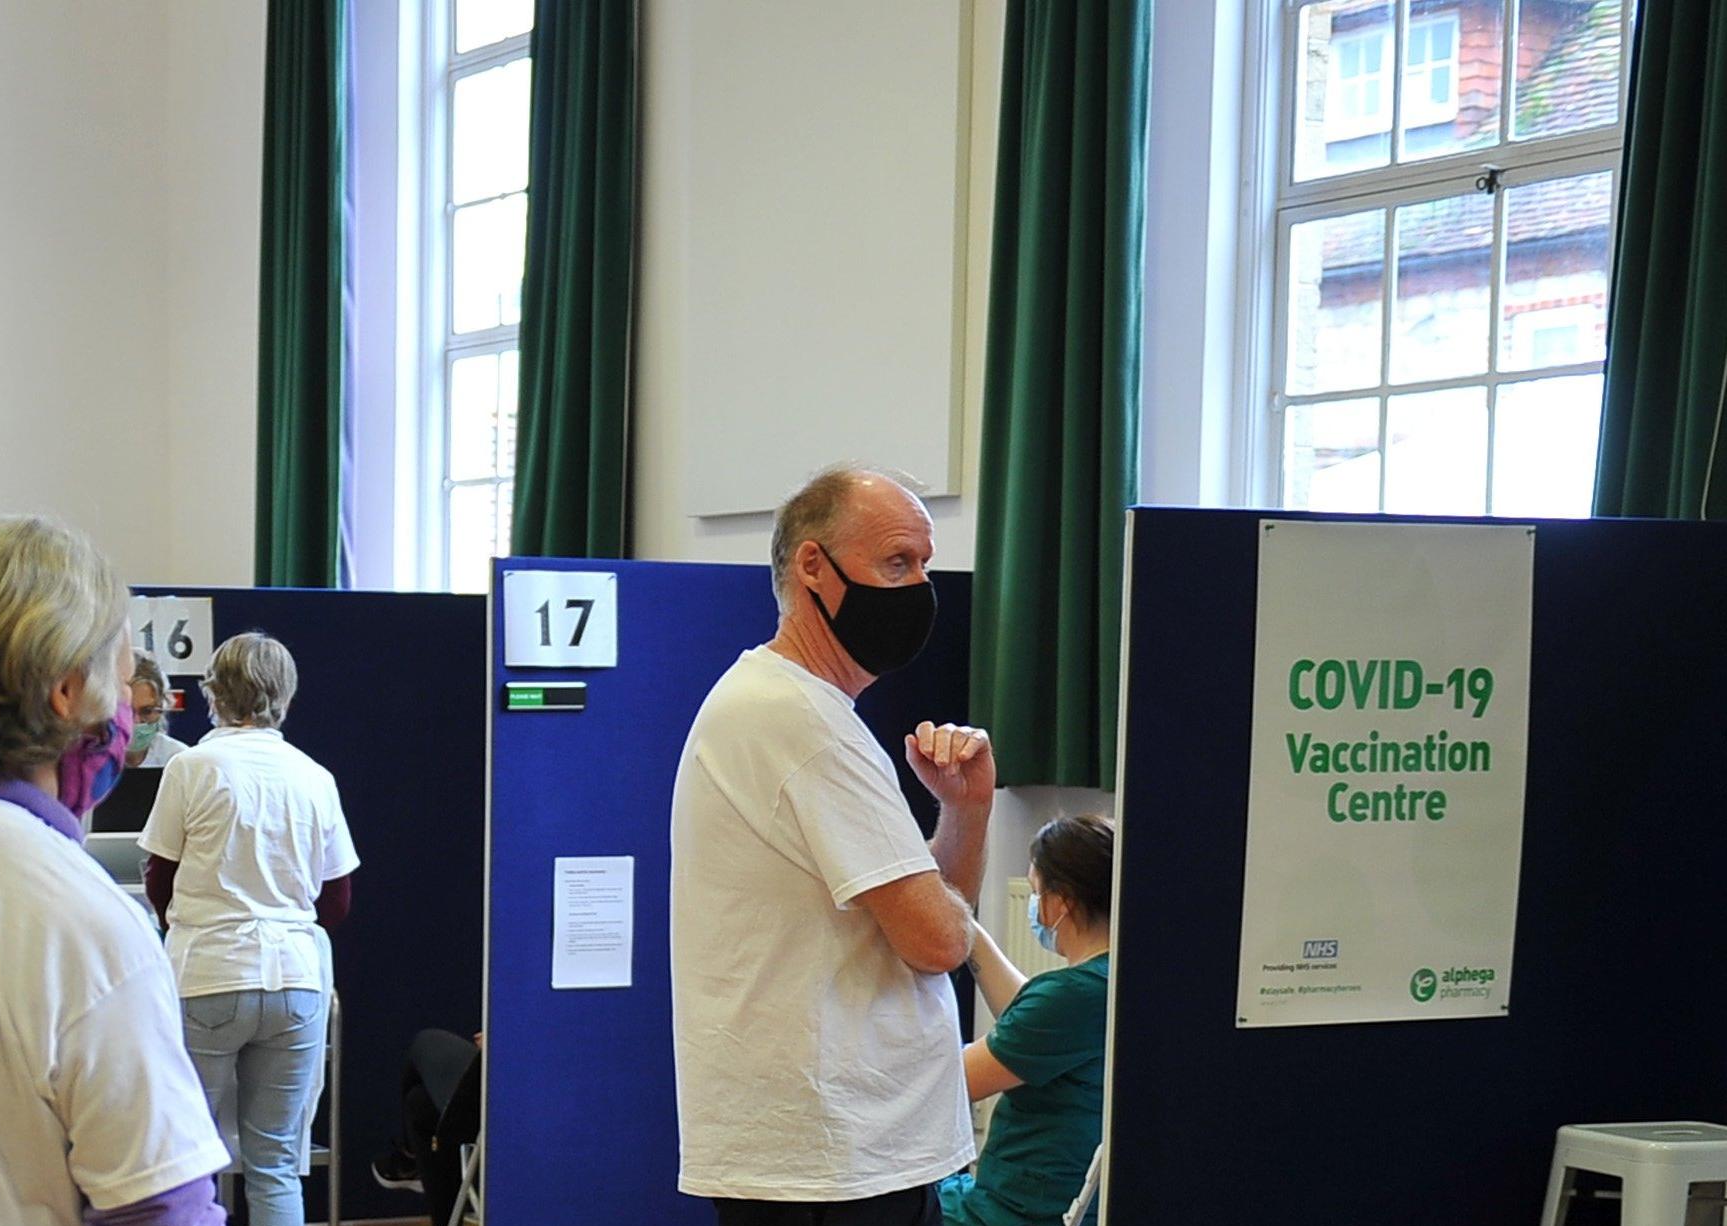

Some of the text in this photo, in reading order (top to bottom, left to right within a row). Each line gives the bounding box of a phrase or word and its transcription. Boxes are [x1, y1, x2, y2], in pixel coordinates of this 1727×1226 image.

[139, 619, 193, 660] 16
[534, 598, 595, 647] 17
[1288, 658, 1494, 718] COVID-19
[1285, 729, 1491, 774] Vaccination
[1326, 781, 1447, 823] Centre
[1262, 964, 1295, 973] Providing
[1303, 941, 1338, 958] NHS
[1440, 985, 1491, 1000] pharmacy
[1441, 966, 1495, 985] alphega
